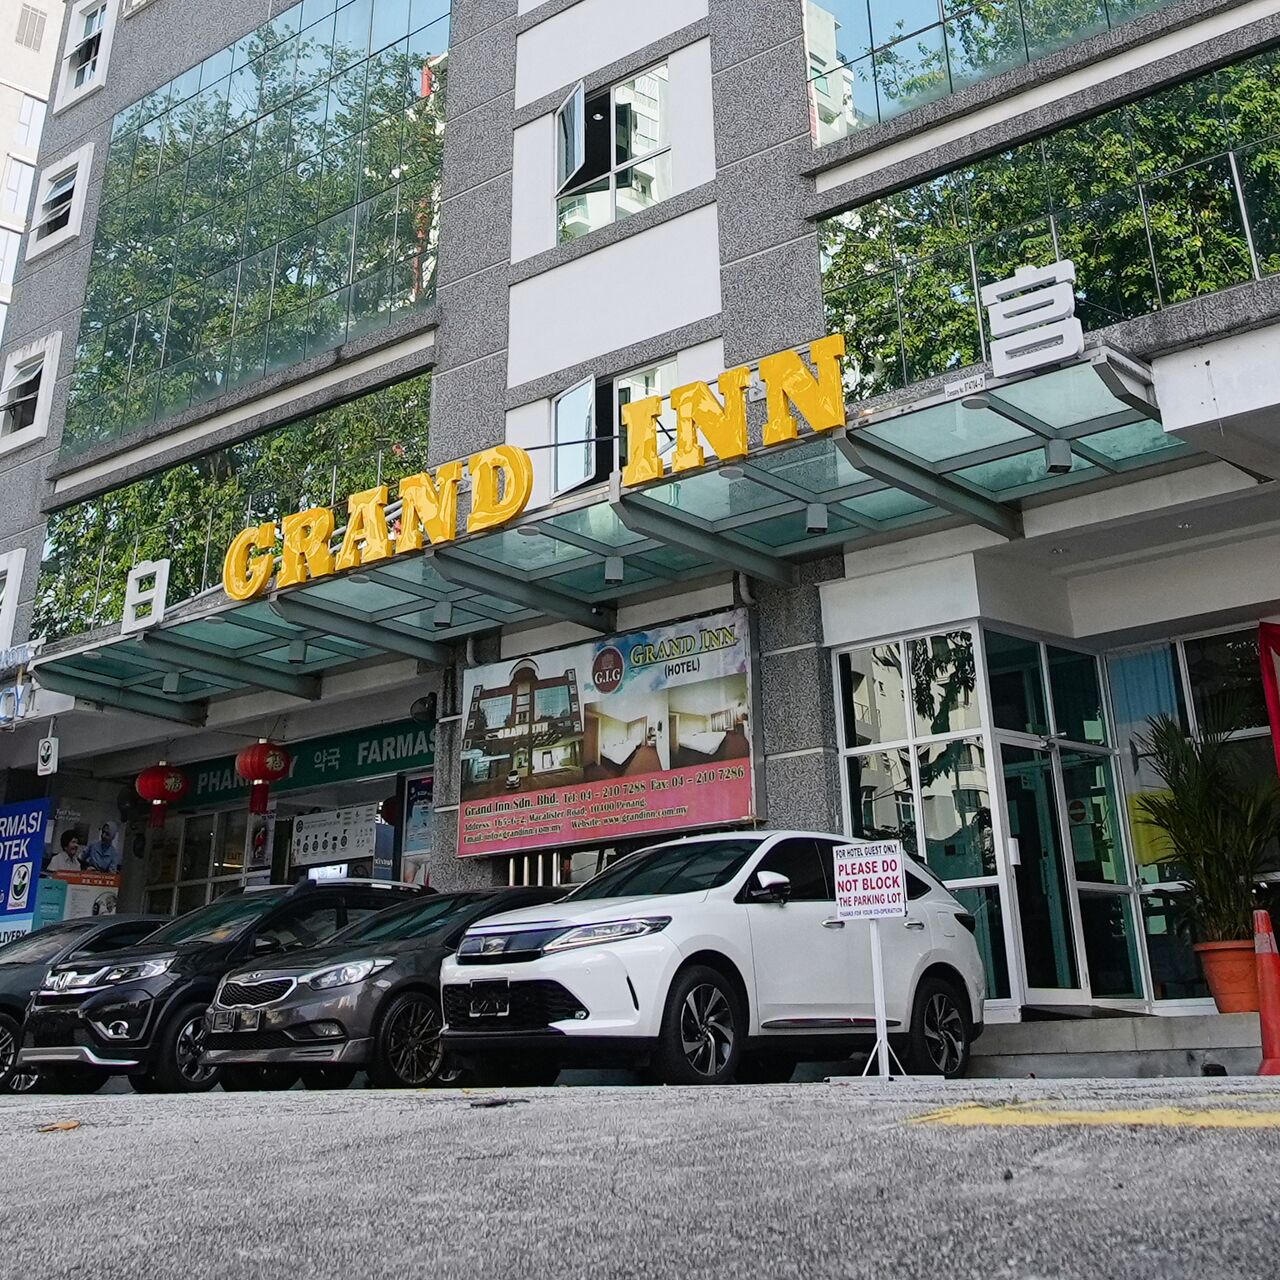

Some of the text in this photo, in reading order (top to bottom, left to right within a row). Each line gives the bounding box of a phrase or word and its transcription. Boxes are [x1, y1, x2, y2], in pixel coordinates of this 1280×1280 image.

[223, 334, 846, 602] GRAND INN
[630, 624, 741, 666] GRAND INN
[594, 668, 621, 685] G.I.G
[664, 657, 701, 679] (HOTEL)
[313, 747, 341, 772] 약국
[465, 799, 494, 817] Grand
[495, 799, 512, 813] Inn
[513, 796, 534, 811] Sdn.
[536, 793, 560, 807] Bhd.
[580, 789, 592, 802] 04
[602, 786, 620, 799] 210
[671, 776, 685, 789] 04
[696, 770, 715, 785] 210
[718, 766, 745, 782] 7286
[836, 843, 898, 859] FOR HOTEL GUEST ONLY
[838, 859, 898, 877] PLEASE DO
[837, 875, 900, 893] NOT BLOCK
[839, 892, 902, 907] THE PARKING LOT
